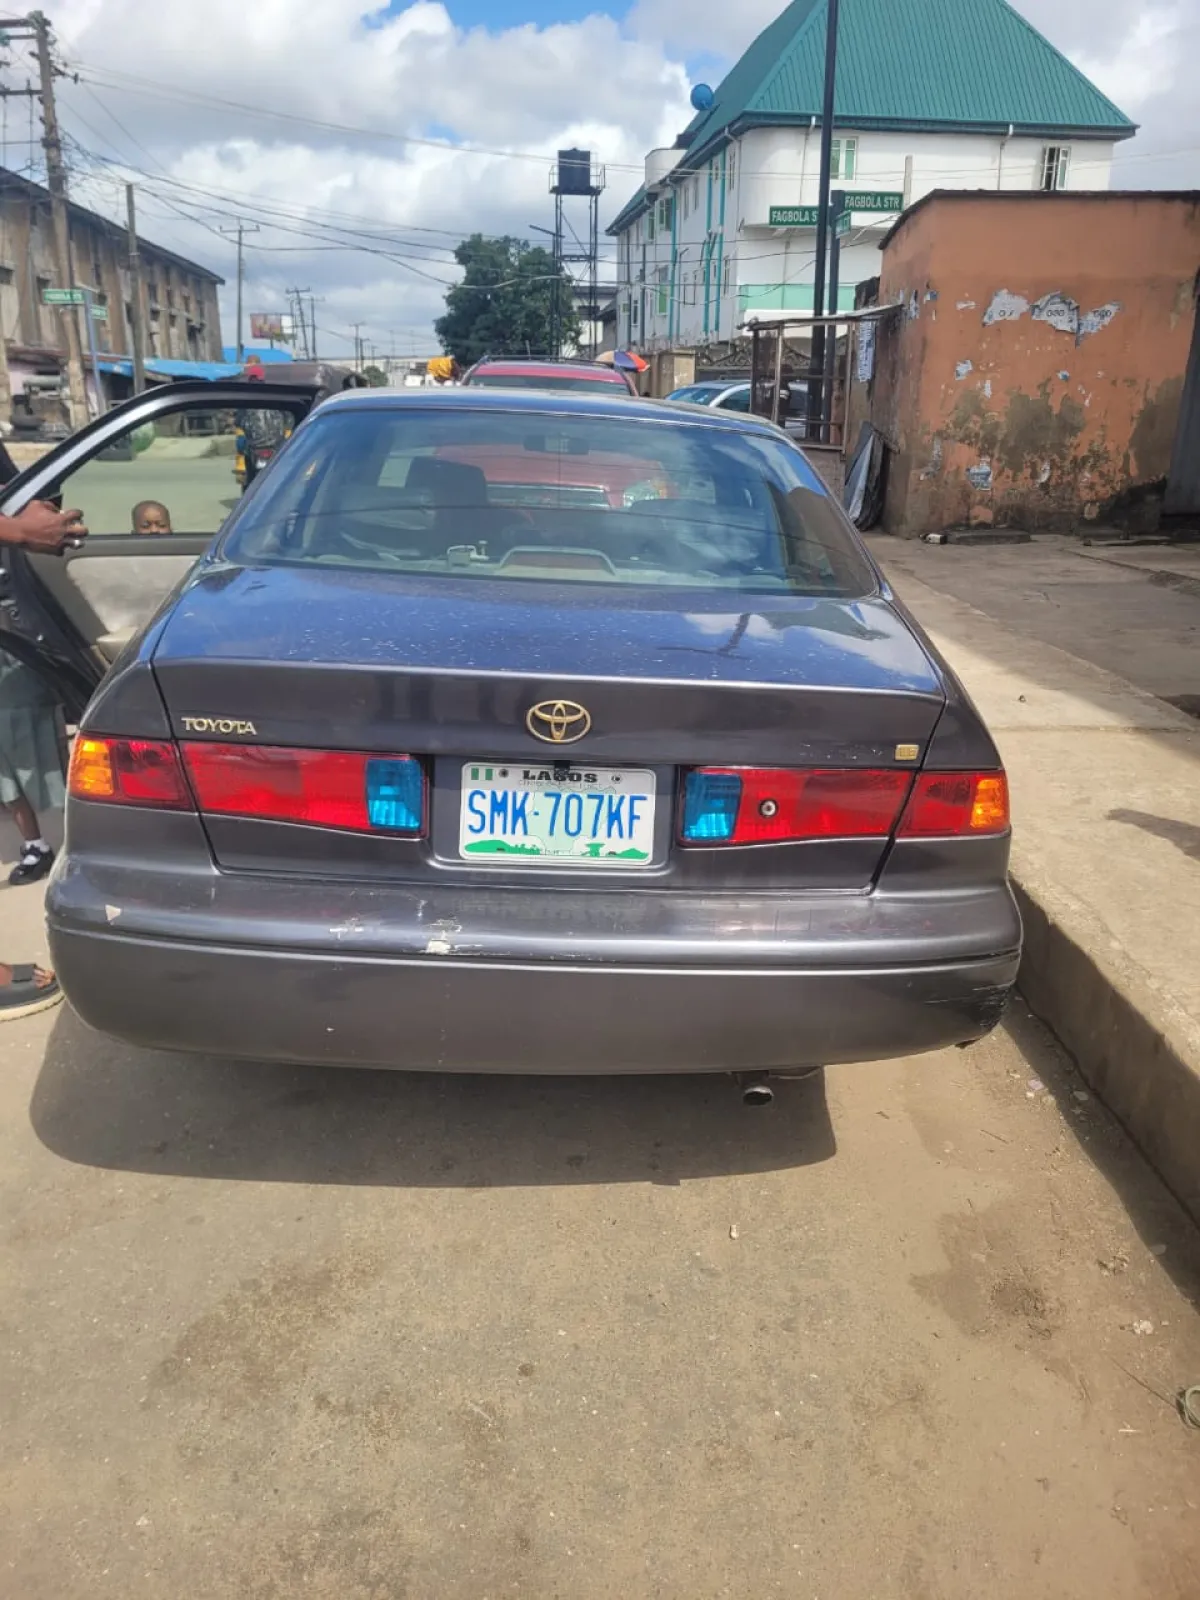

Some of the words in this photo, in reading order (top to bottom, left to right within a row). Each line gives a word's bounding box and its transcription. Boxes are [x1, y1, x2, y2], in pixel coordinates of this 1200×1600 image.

[844, 196, 881, 208] FAGBOLA
[883, 197, 900, 208] STR
[771, 210, 810, 222] FAGBOLA
[181, 716, 257, 735] TOYOTA
[468, 790, 648, 839] SMK-707KF
